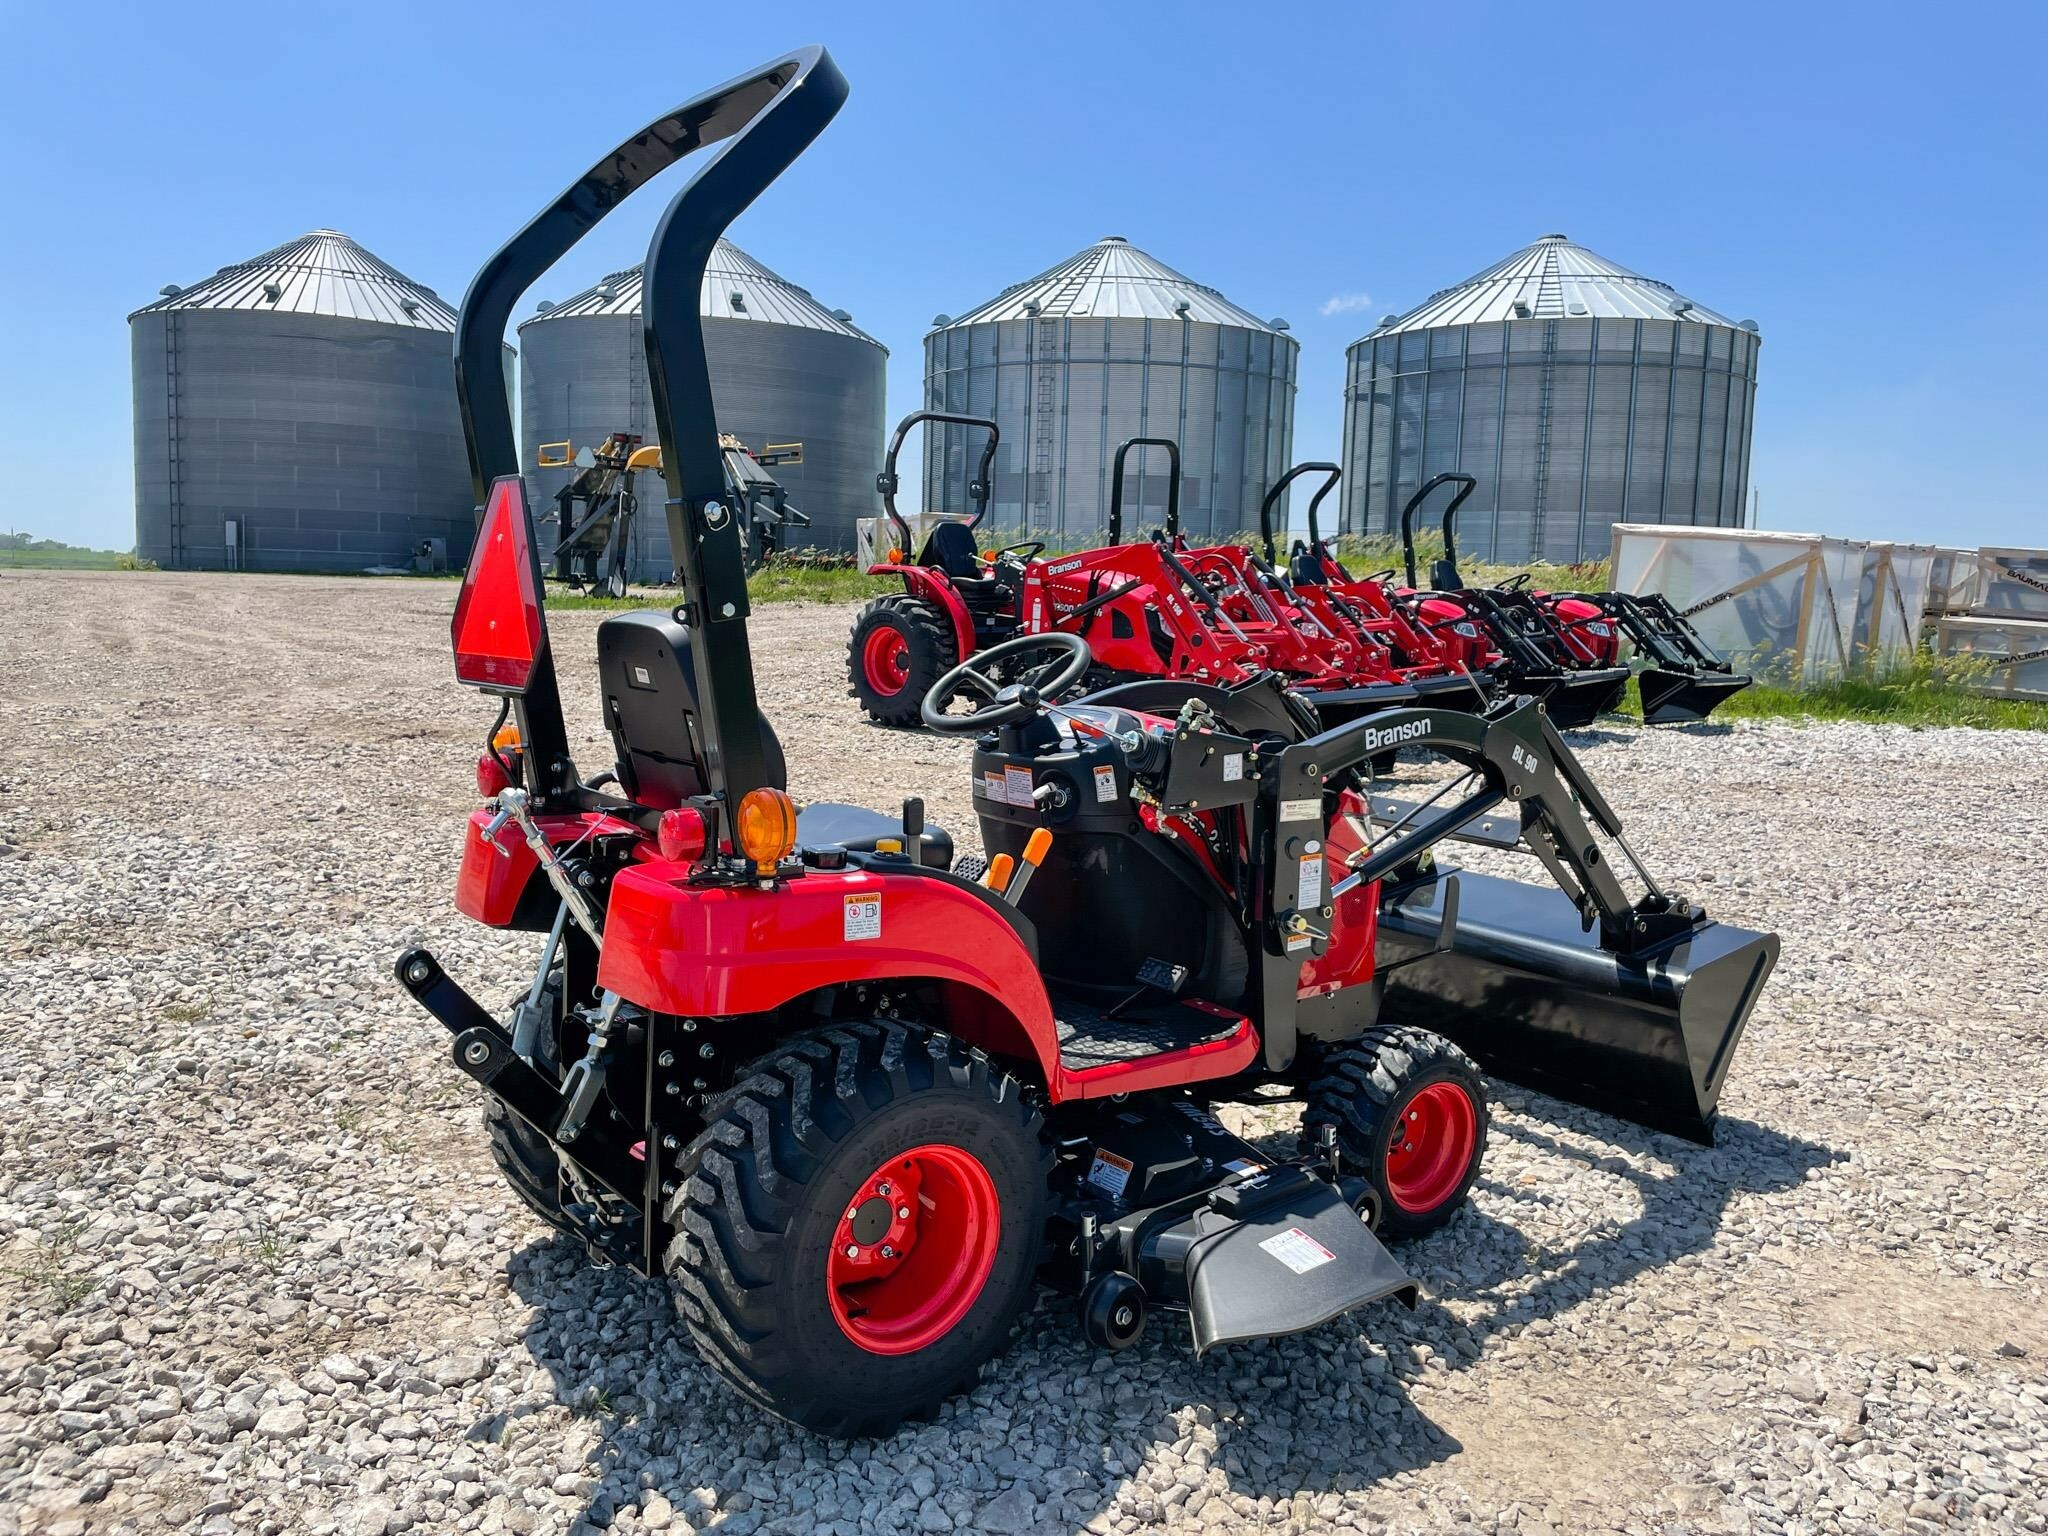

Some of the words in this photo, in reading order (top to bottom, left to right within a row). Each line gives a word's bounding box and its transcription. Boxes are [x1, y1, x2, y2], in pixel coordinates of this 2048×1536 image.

[1048, 559, 1082, 576] Branson
[1365, 717, 1431, 750] Branson
[1511, 744, 1524, 765] BL
[1524, 753, 1538, 774] 90
